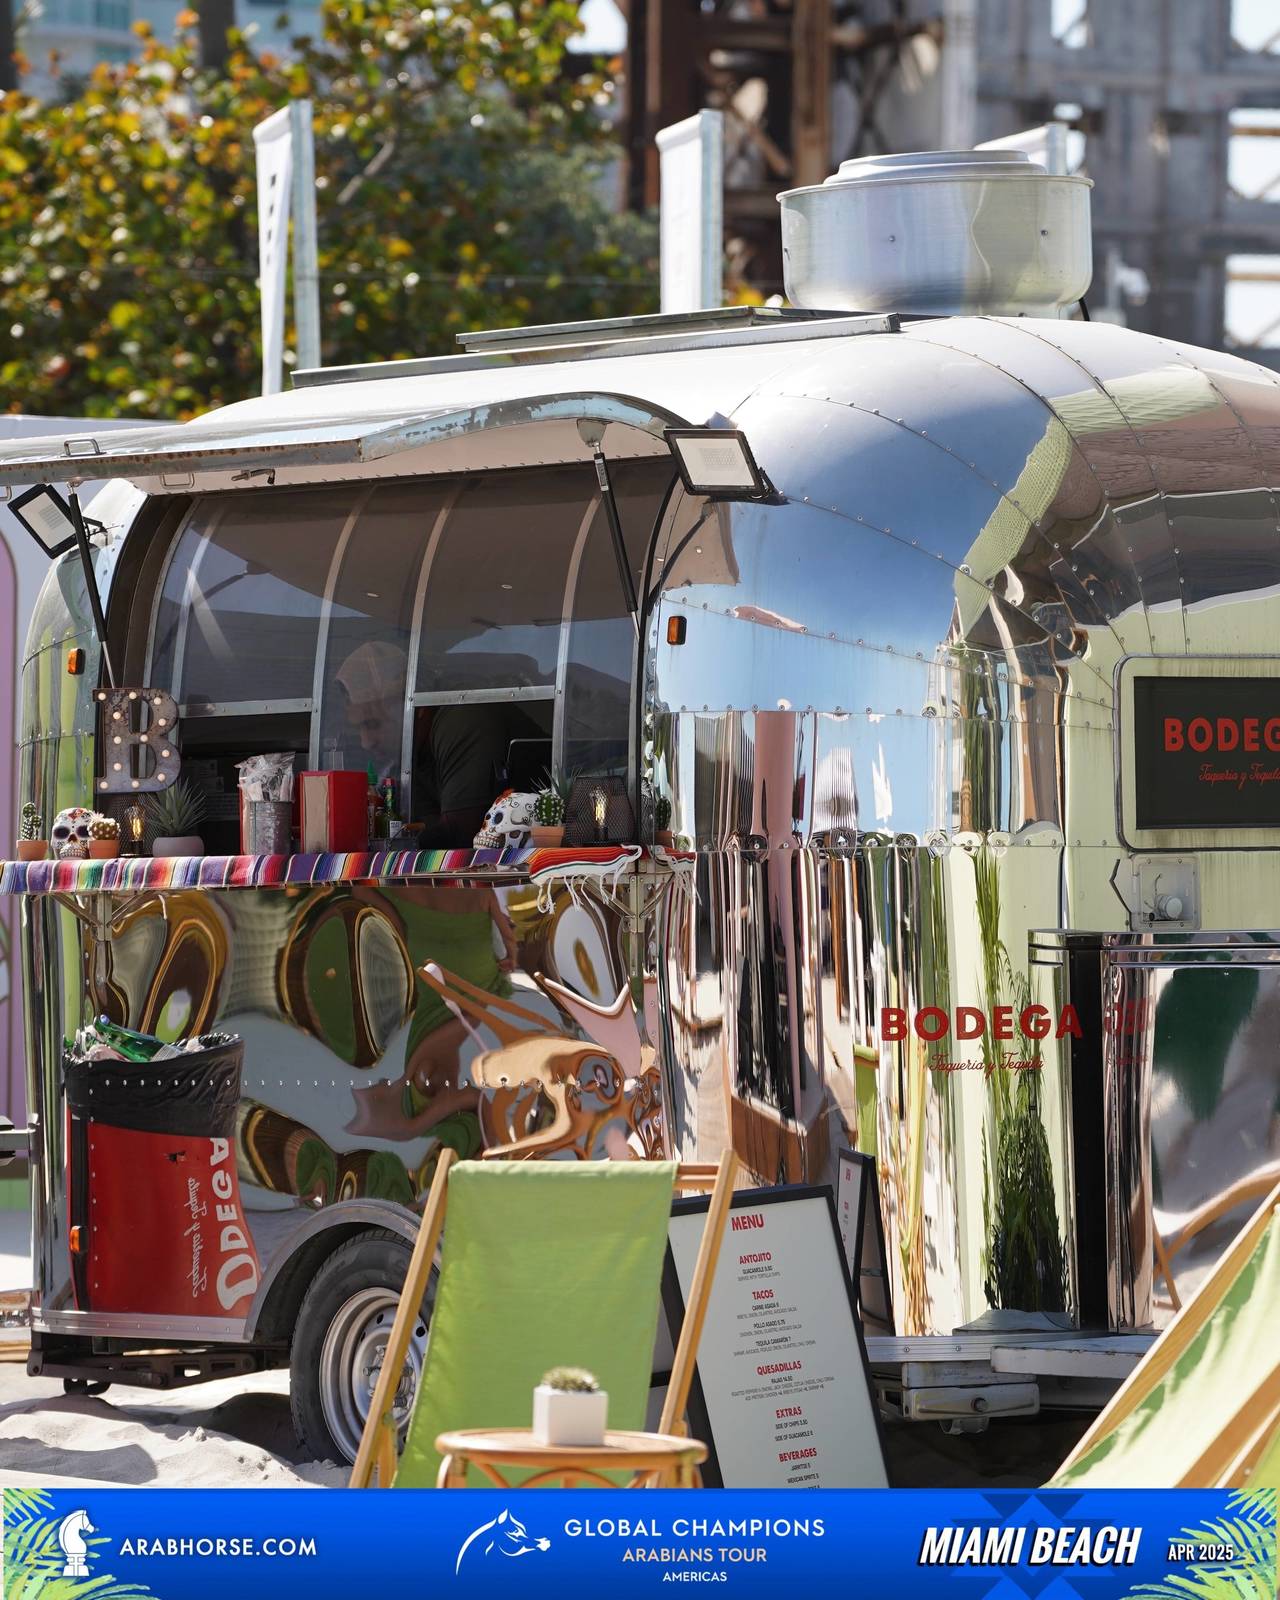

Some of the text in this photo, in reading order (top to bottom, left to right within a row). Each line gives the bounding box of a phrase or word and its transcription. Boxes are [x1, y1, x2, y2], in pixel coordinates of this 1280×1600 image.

[93, 688, 181, 794] B
[1164, 717, 1280, 752] BODEG
[1237, 772, 1247, 791] y
[1249, 763, 1280, 786] Tequil
[881, 1004, 1083, 1041] BODEGA
[984, 1062, 996, 1080] y
[1000, 1052, 1044, 1075] Tequila
[731, 1213, 764, 1231] MENU
[739, 1252, 772, 1265] ANTOJITO
[752, 1289, 774, 1300] TACOS
[757, 1360, 802, 1376] QUESADILLAS
[775, 1406, 802, 1419] EXTRAS
[778, 1447, 818, 1462] BEVERAGES
